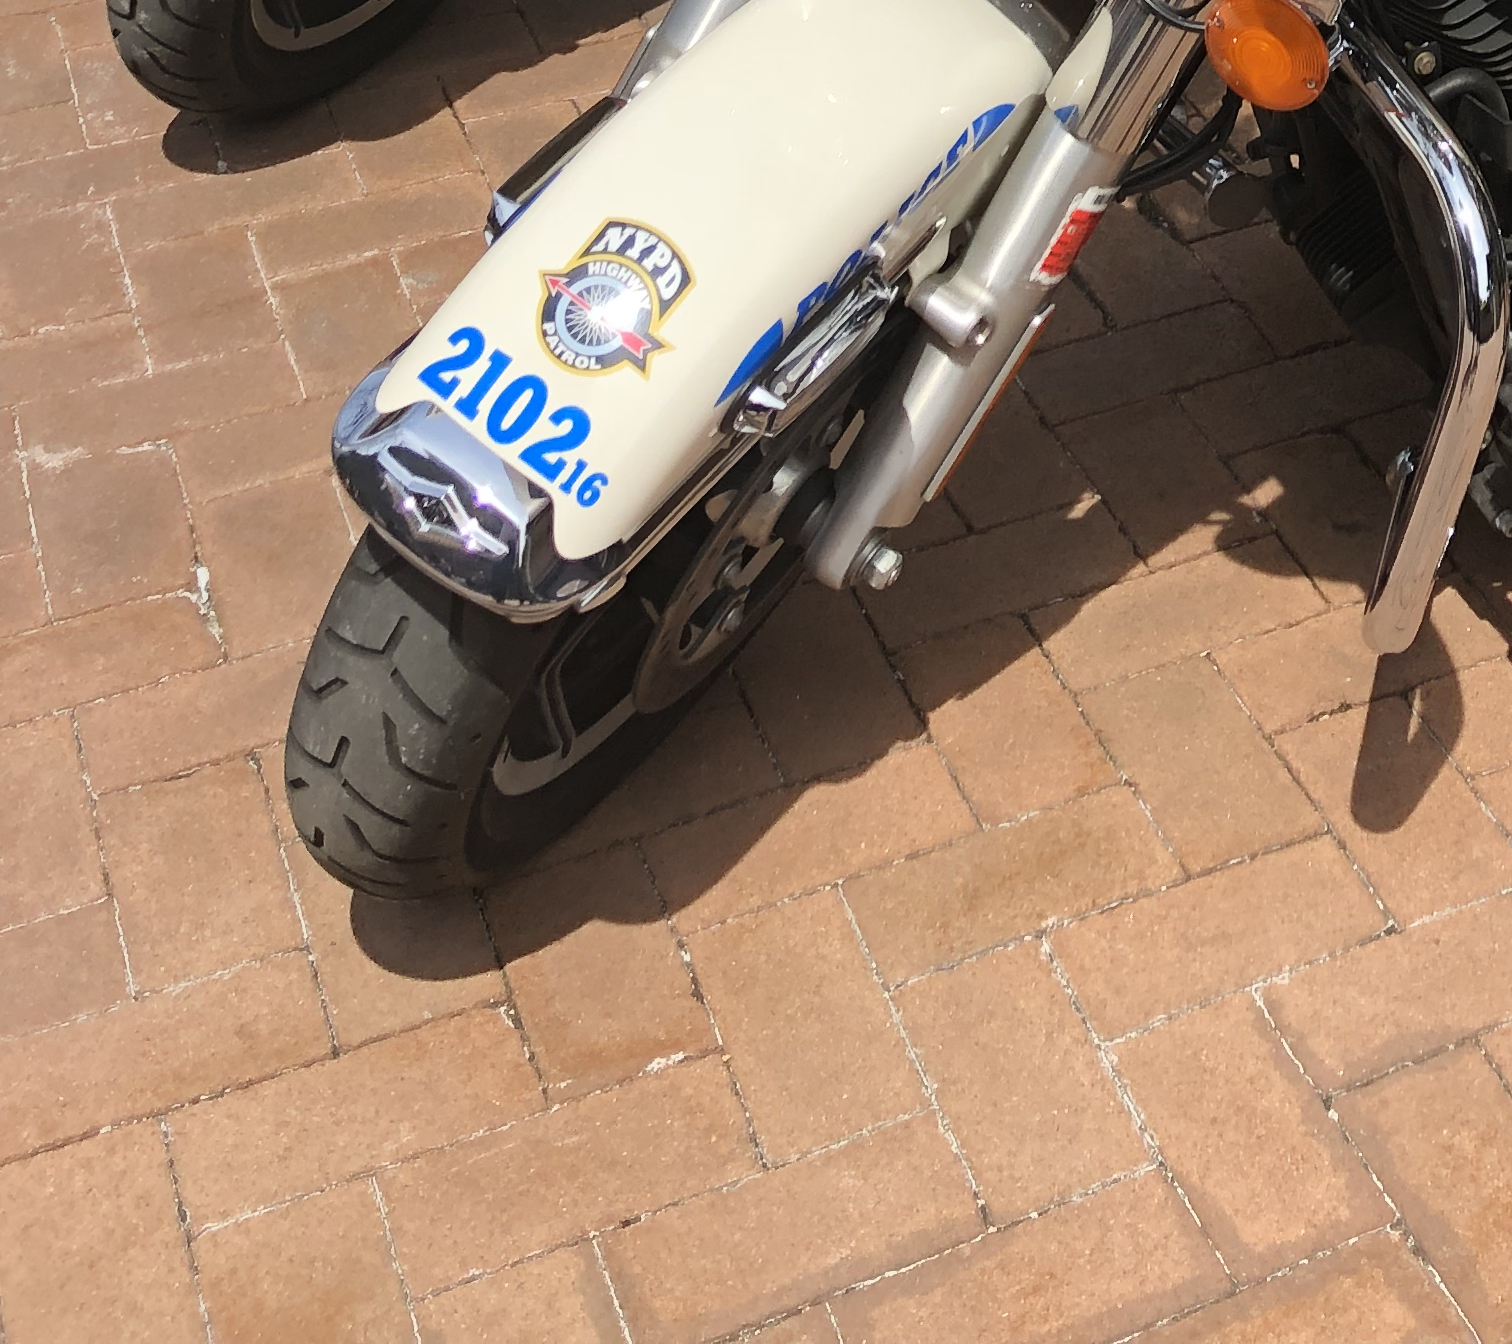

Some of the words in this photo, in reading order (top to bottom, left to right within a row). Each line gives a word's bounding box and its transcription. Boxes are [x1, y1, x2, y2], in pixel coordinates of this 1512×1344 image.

[589, 226, 684, 301] NYPD
[542, 322, 601, 370] PATROL
[417, 326, 591, 483] 2102
[559, 458, 609, 508] 16
